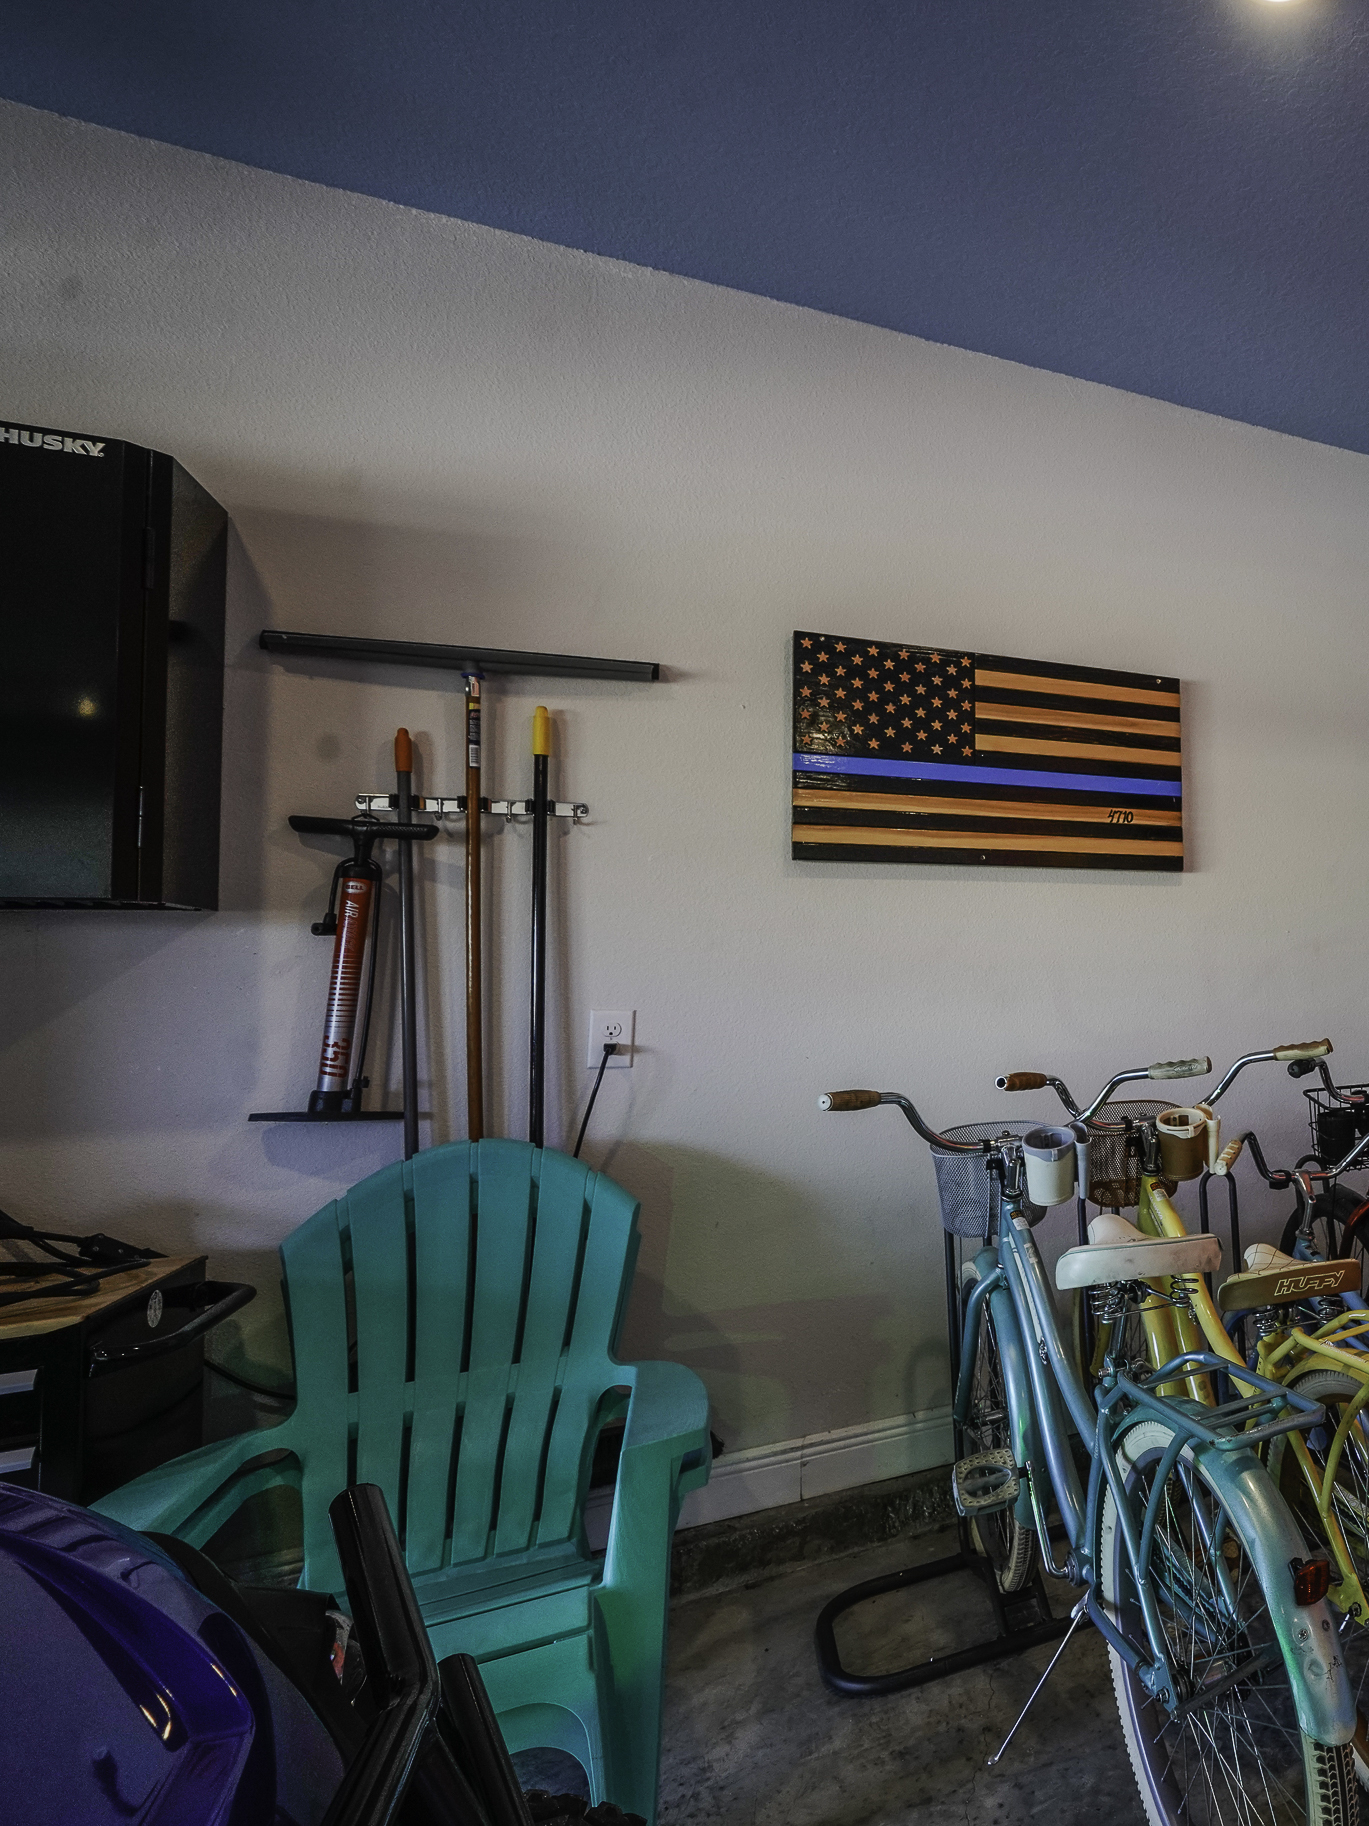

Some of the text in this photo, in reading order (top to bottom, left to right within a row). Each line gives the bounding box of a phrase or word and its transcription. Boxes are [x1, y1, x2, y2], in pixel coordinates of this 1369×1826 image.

[1107, 809, 1134, 824] 4710
[344, 900, 360, 918] AIR
[320, 1034, 350, 1079] 350
[1274, 1270, 1346, 1296] HUFFY
